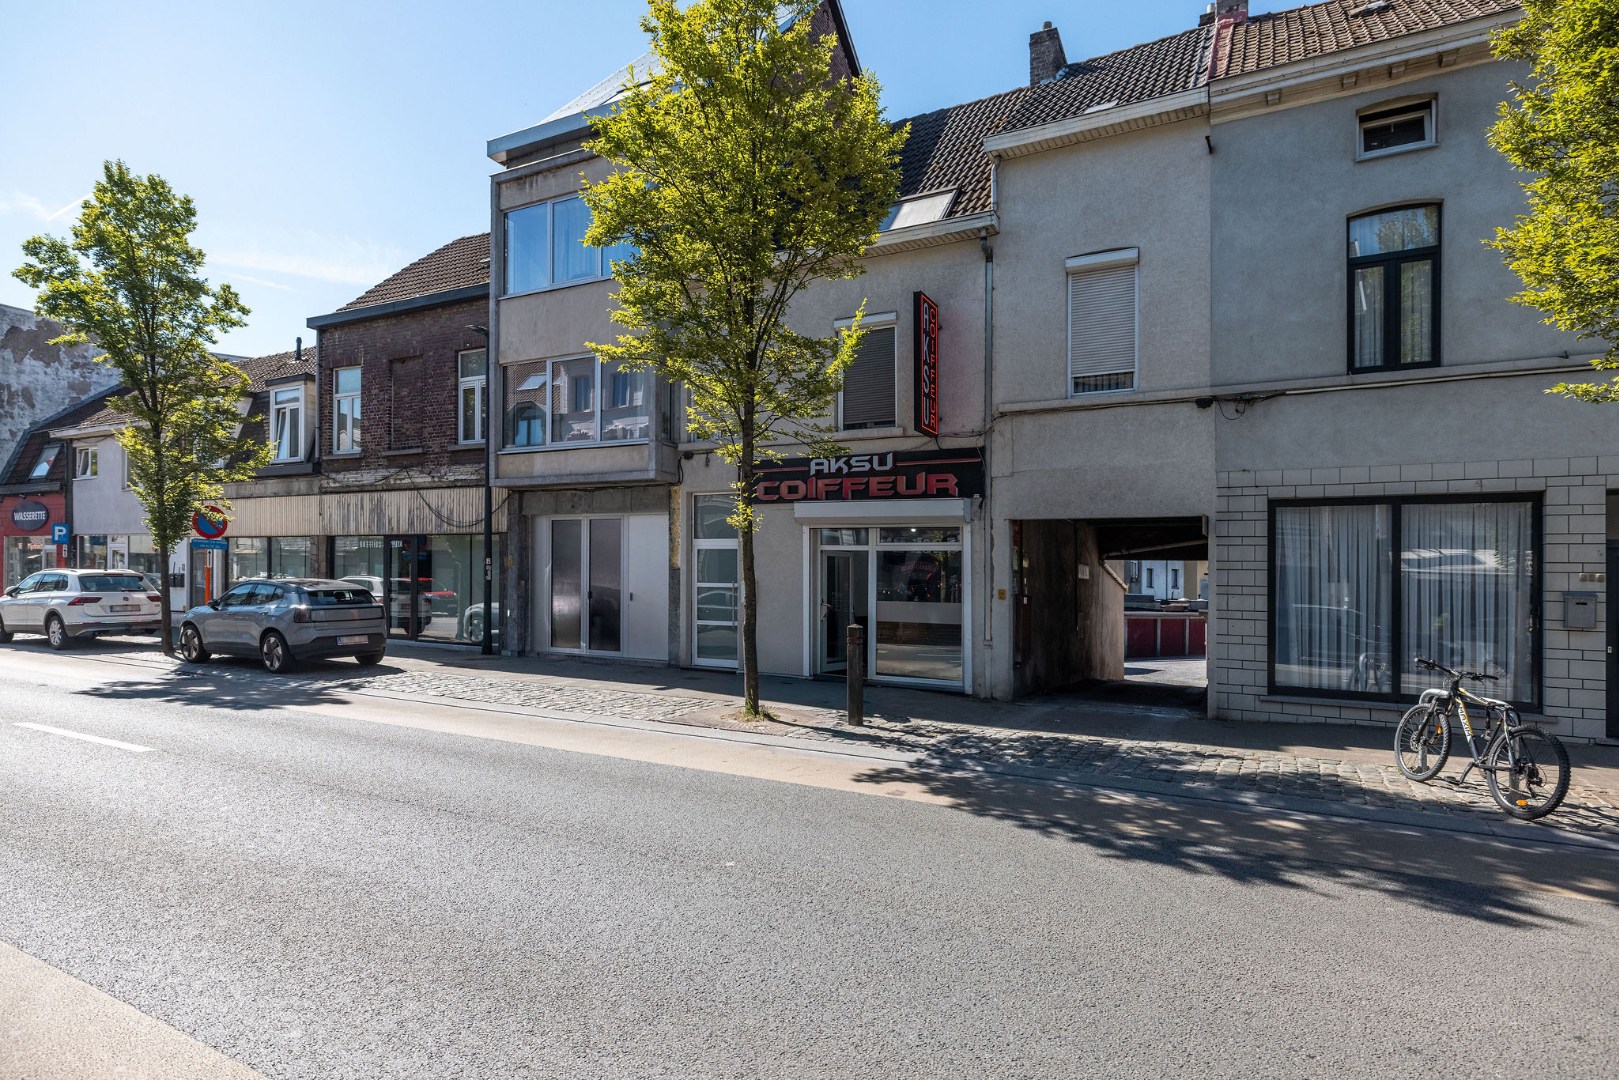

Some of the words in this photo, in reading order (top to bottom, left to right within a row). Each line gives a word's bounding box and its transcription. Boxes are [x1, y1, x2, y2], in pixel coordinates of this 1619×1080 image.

[810, 453, 893, 475] AKSU
[757, 472, 958, 500] COIFFEUR
[13, 510, 46, 521] WASSERETTE
[54, 526, 67, 541] P
